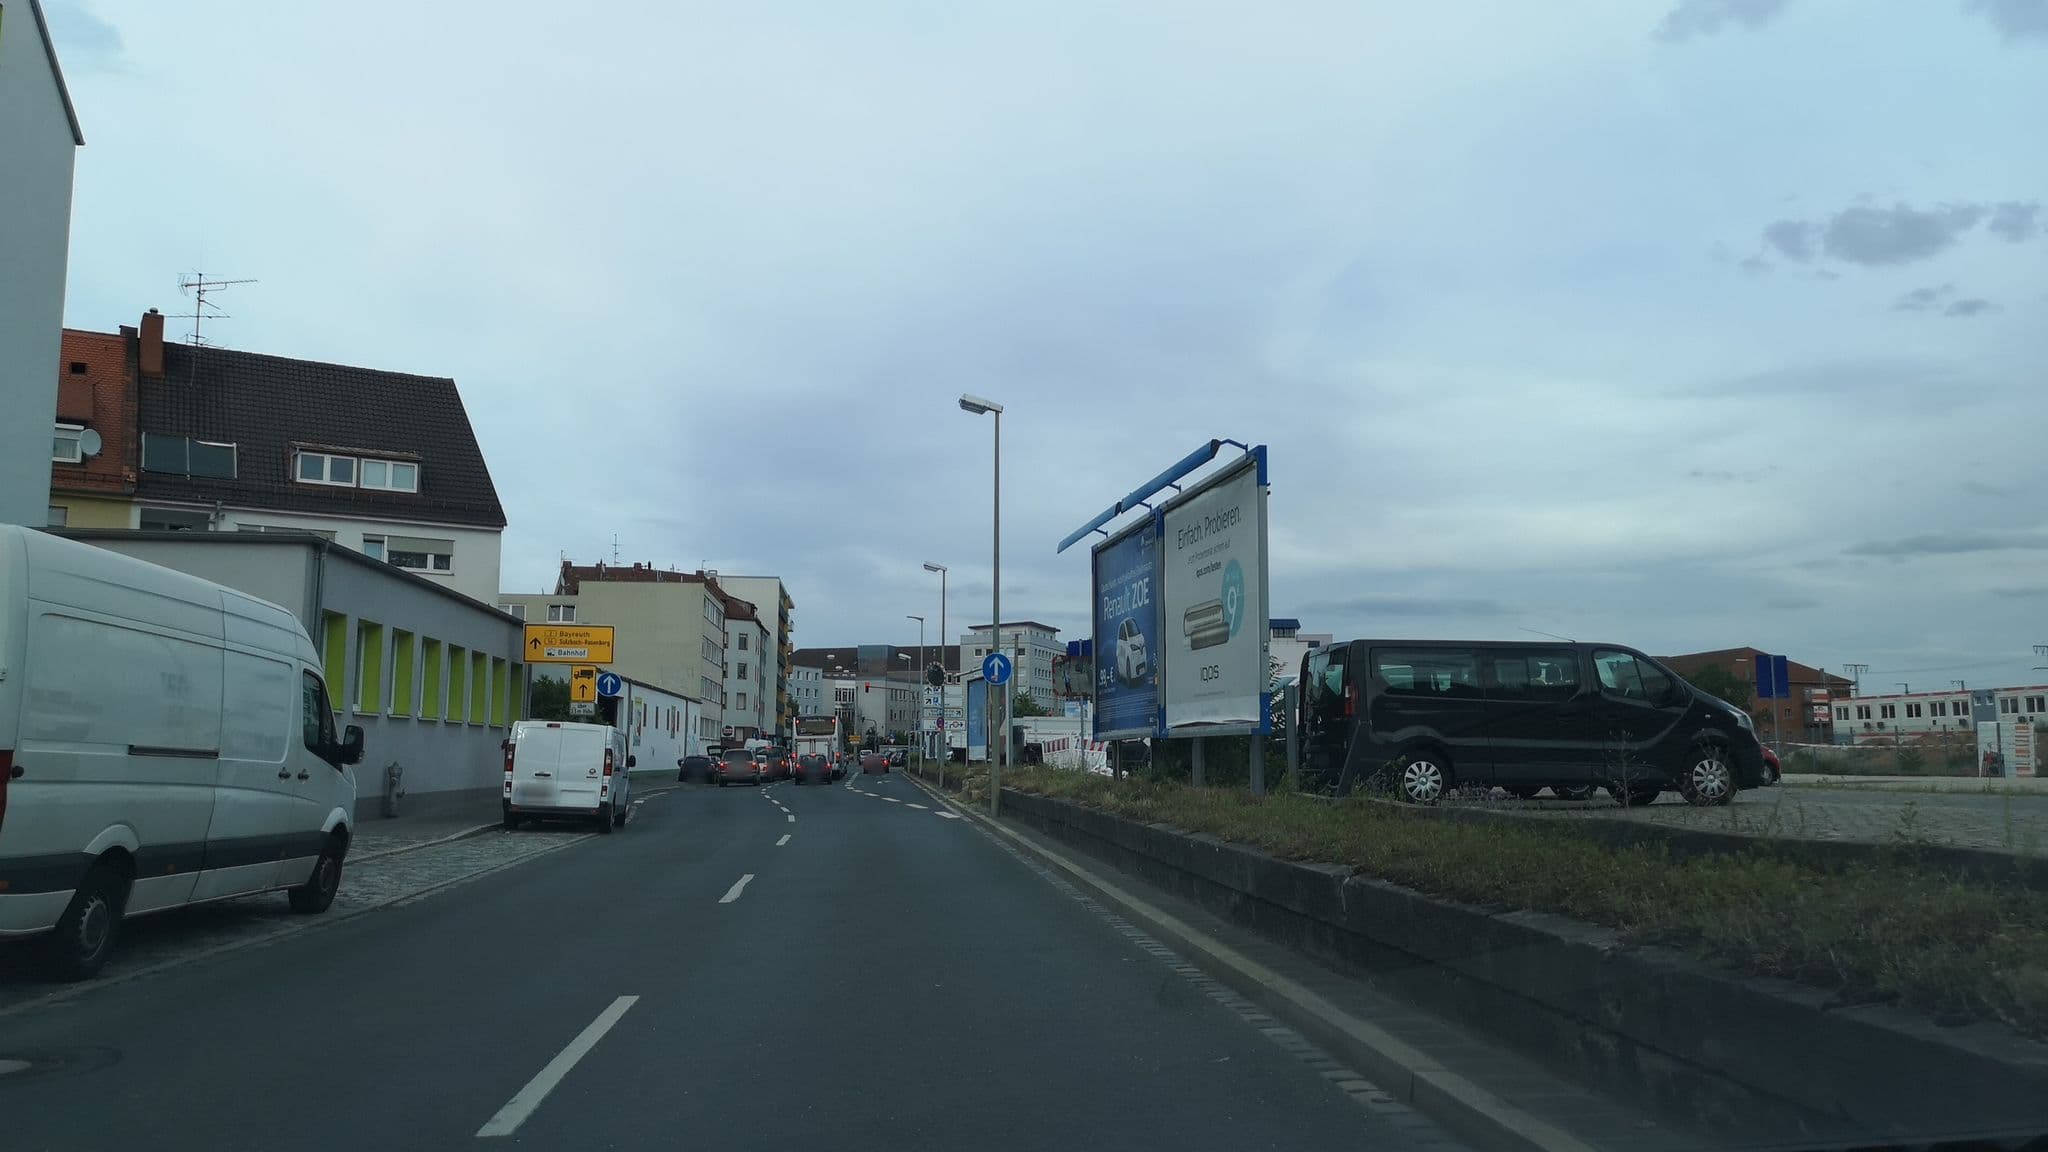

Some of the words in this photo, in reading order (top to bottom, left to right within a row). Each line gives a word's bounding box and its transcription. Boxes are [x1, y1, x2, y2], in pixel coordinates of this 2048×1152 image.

[1178, 521, 1203, 550] Einfach.
[1204, 506, 1242, 538] Probieren.
[1103, 586, 1131, 621] Renault
[1132, 577, 1150, 609] ZOE
[559, 639, 611, 647] Sulzbach-Rosenberg
[557, 649, 586, 657] Bahnhof
[1200, 665, 1220, 683] IQOS
